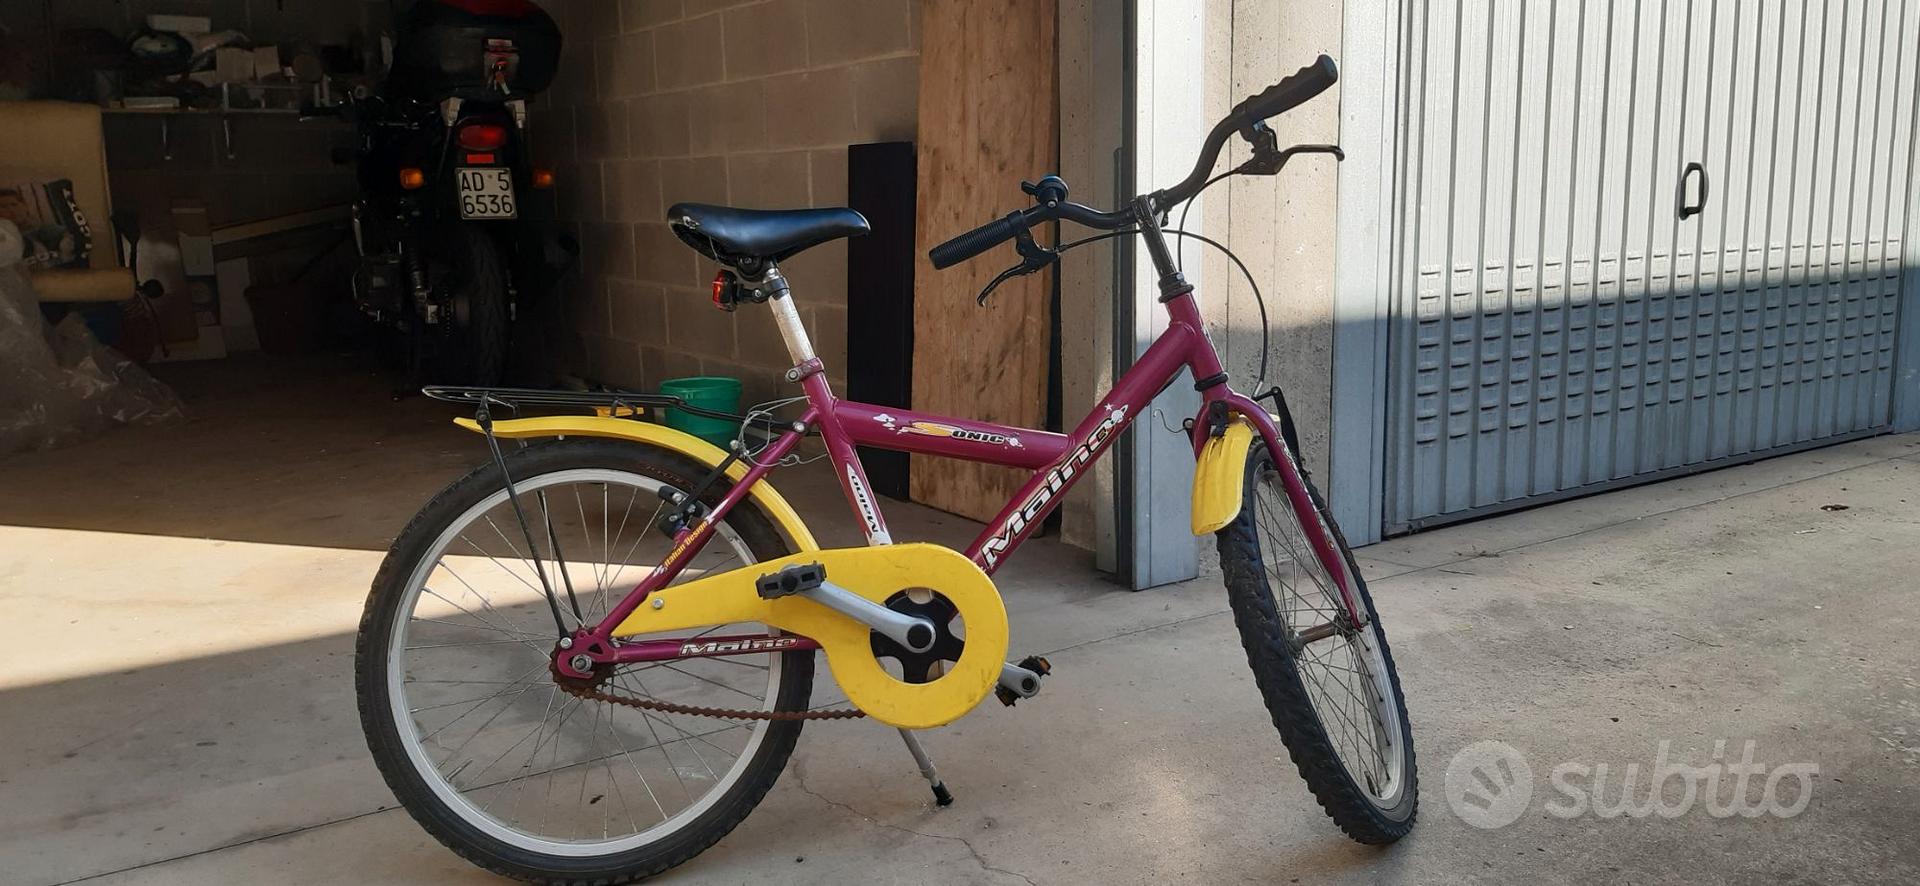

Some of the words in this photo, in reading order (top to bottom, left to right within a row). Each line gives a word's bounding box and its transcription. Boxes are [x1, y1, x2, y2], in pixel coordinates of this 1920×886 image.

[461, 171, 485, 192] AD
[497, 171, 510, 192] 5
[463, 194, 513, 214] 6536
